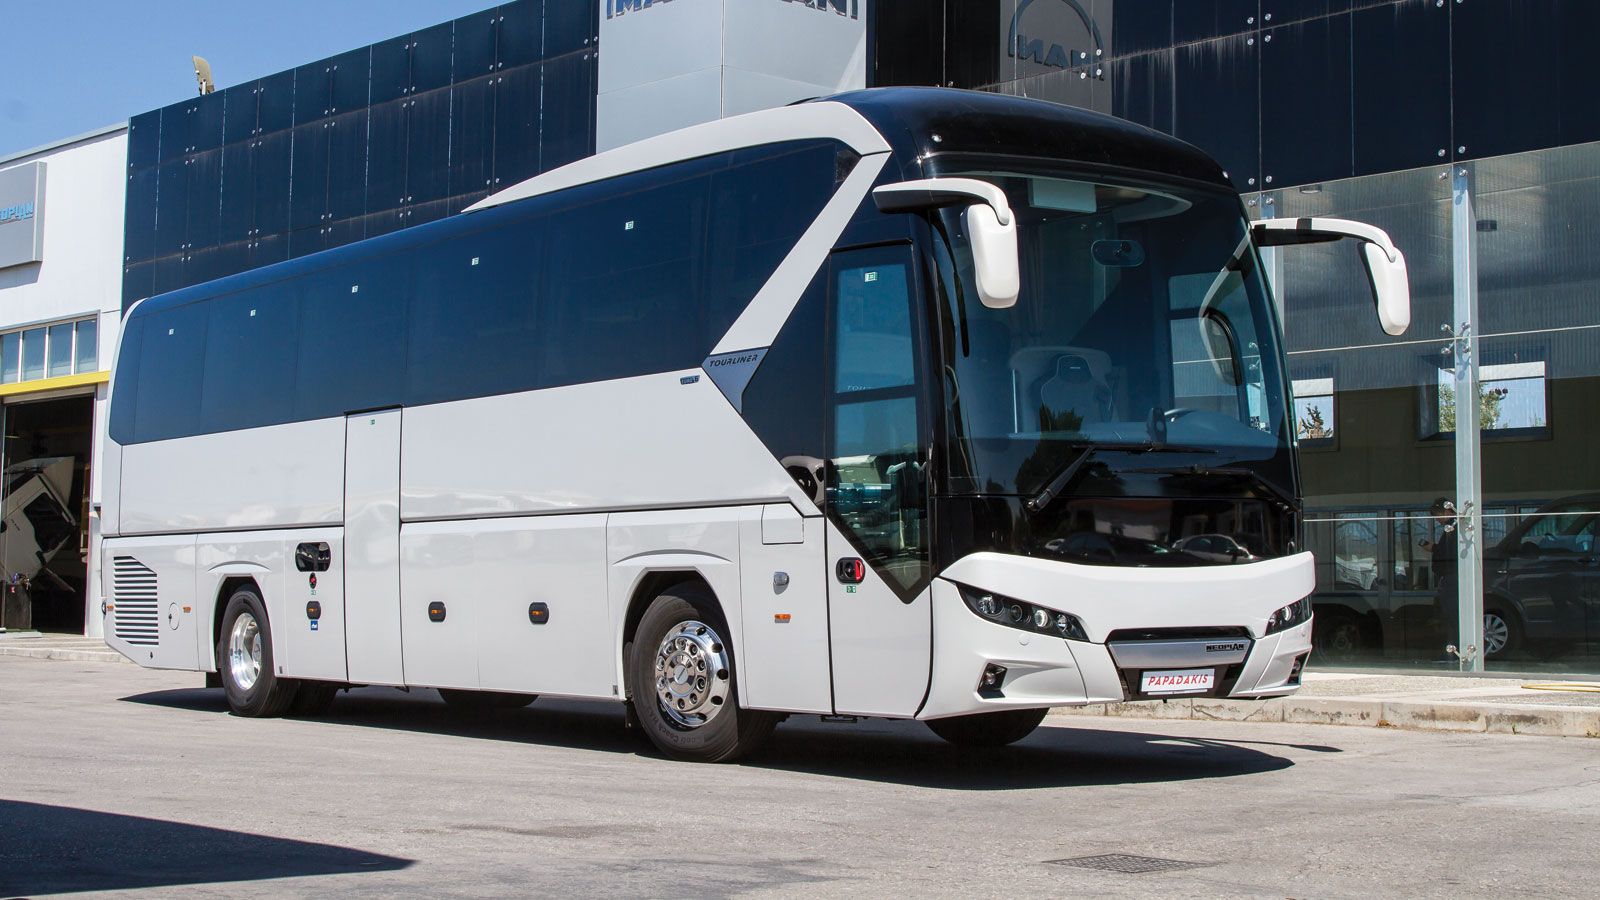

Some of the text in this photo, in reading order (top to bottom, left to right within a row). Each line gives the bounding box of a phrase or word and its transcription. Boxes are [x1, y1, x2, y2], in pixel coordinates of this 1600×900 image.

[709, 354, 758, 367] TOURLINER
[1206, 643, 1245, 652] NEOPLAN
[1148, 674, 1208, 686] PAPADAKIS
